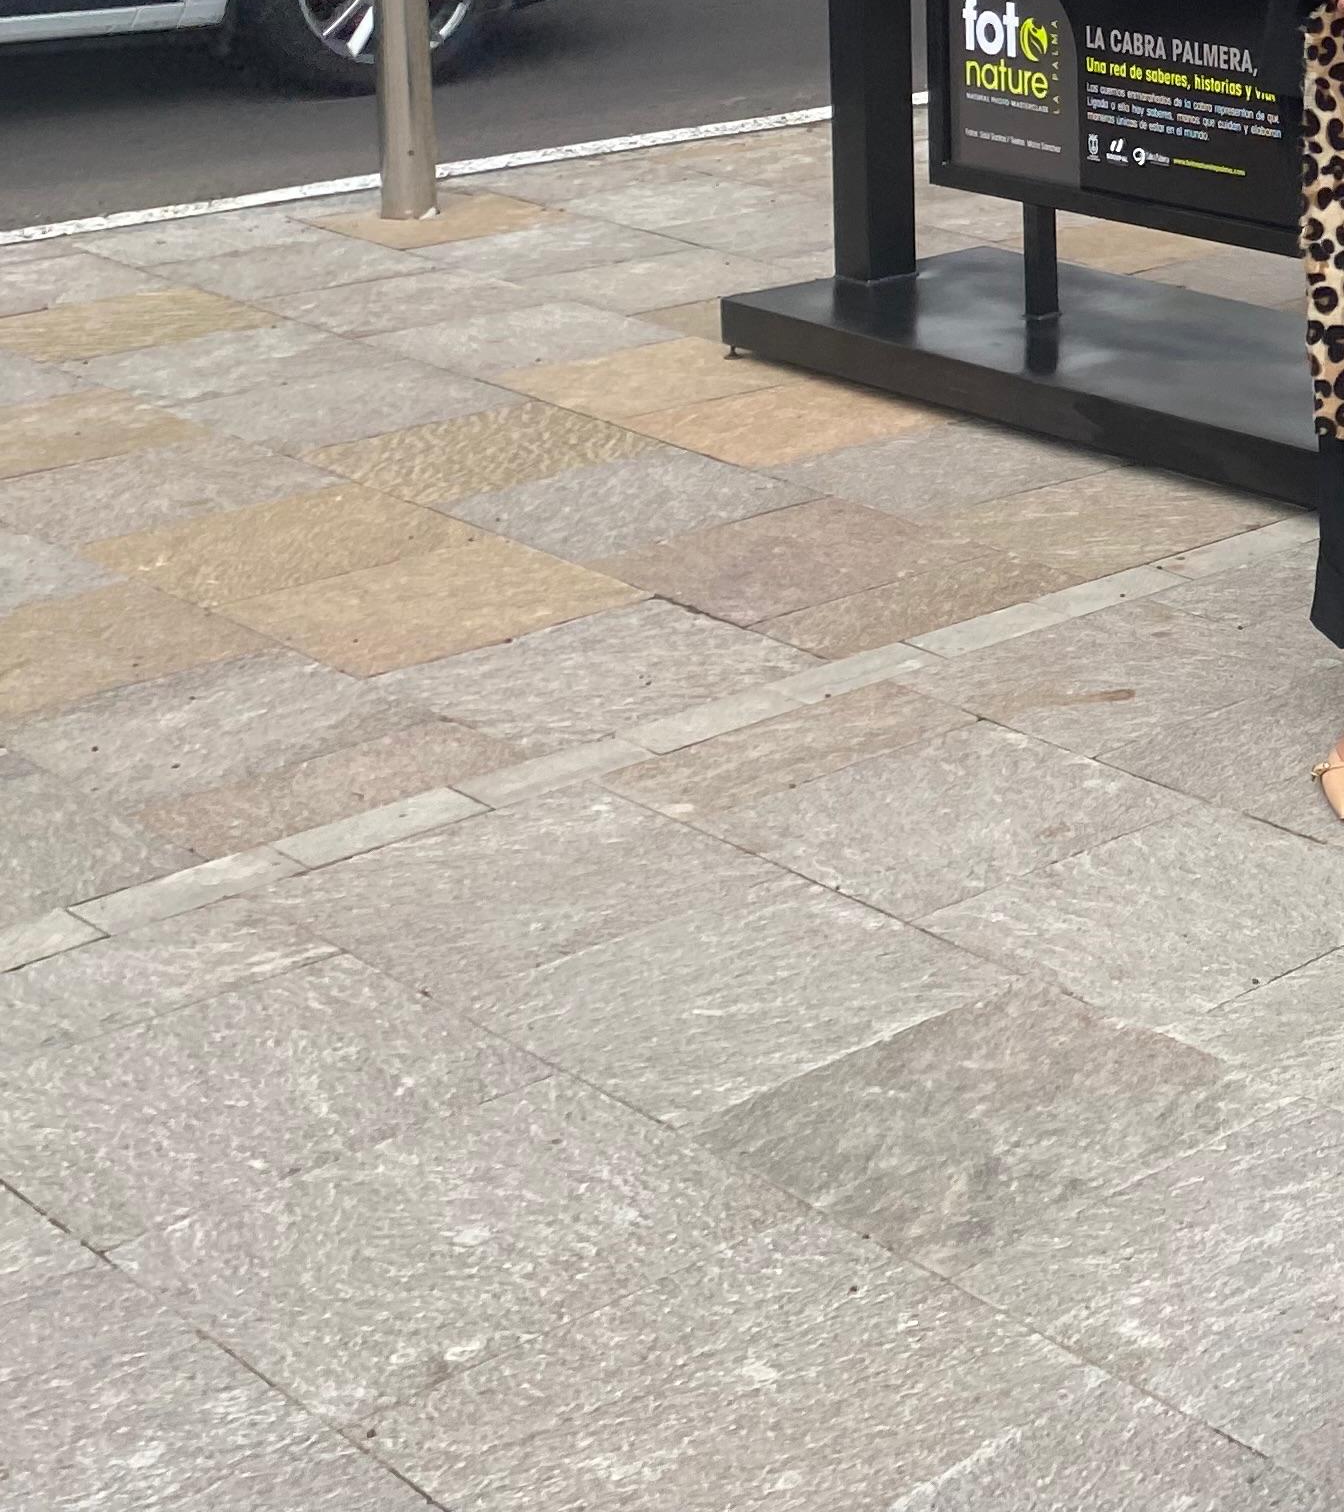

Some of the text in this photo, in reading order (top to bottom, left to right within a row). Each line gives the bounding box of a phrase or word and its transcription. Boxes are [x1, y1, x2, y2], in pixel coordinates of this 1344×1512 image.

[1051, 19, 1059, 81] PALMA
[1086, 25, 1258, 77] LA CABRA PALMERA,
[965, 59, 1049, 99] nature
[1086, 56, 1107, 73] Una
[1109, 63, 1127, 78] red
[1129, 64, 1143, 80] de
[1145, 68, 1191, 90] saberes,
[1194, 74, 1242, 97] historias
[1245, 85, 1252, 101] y
